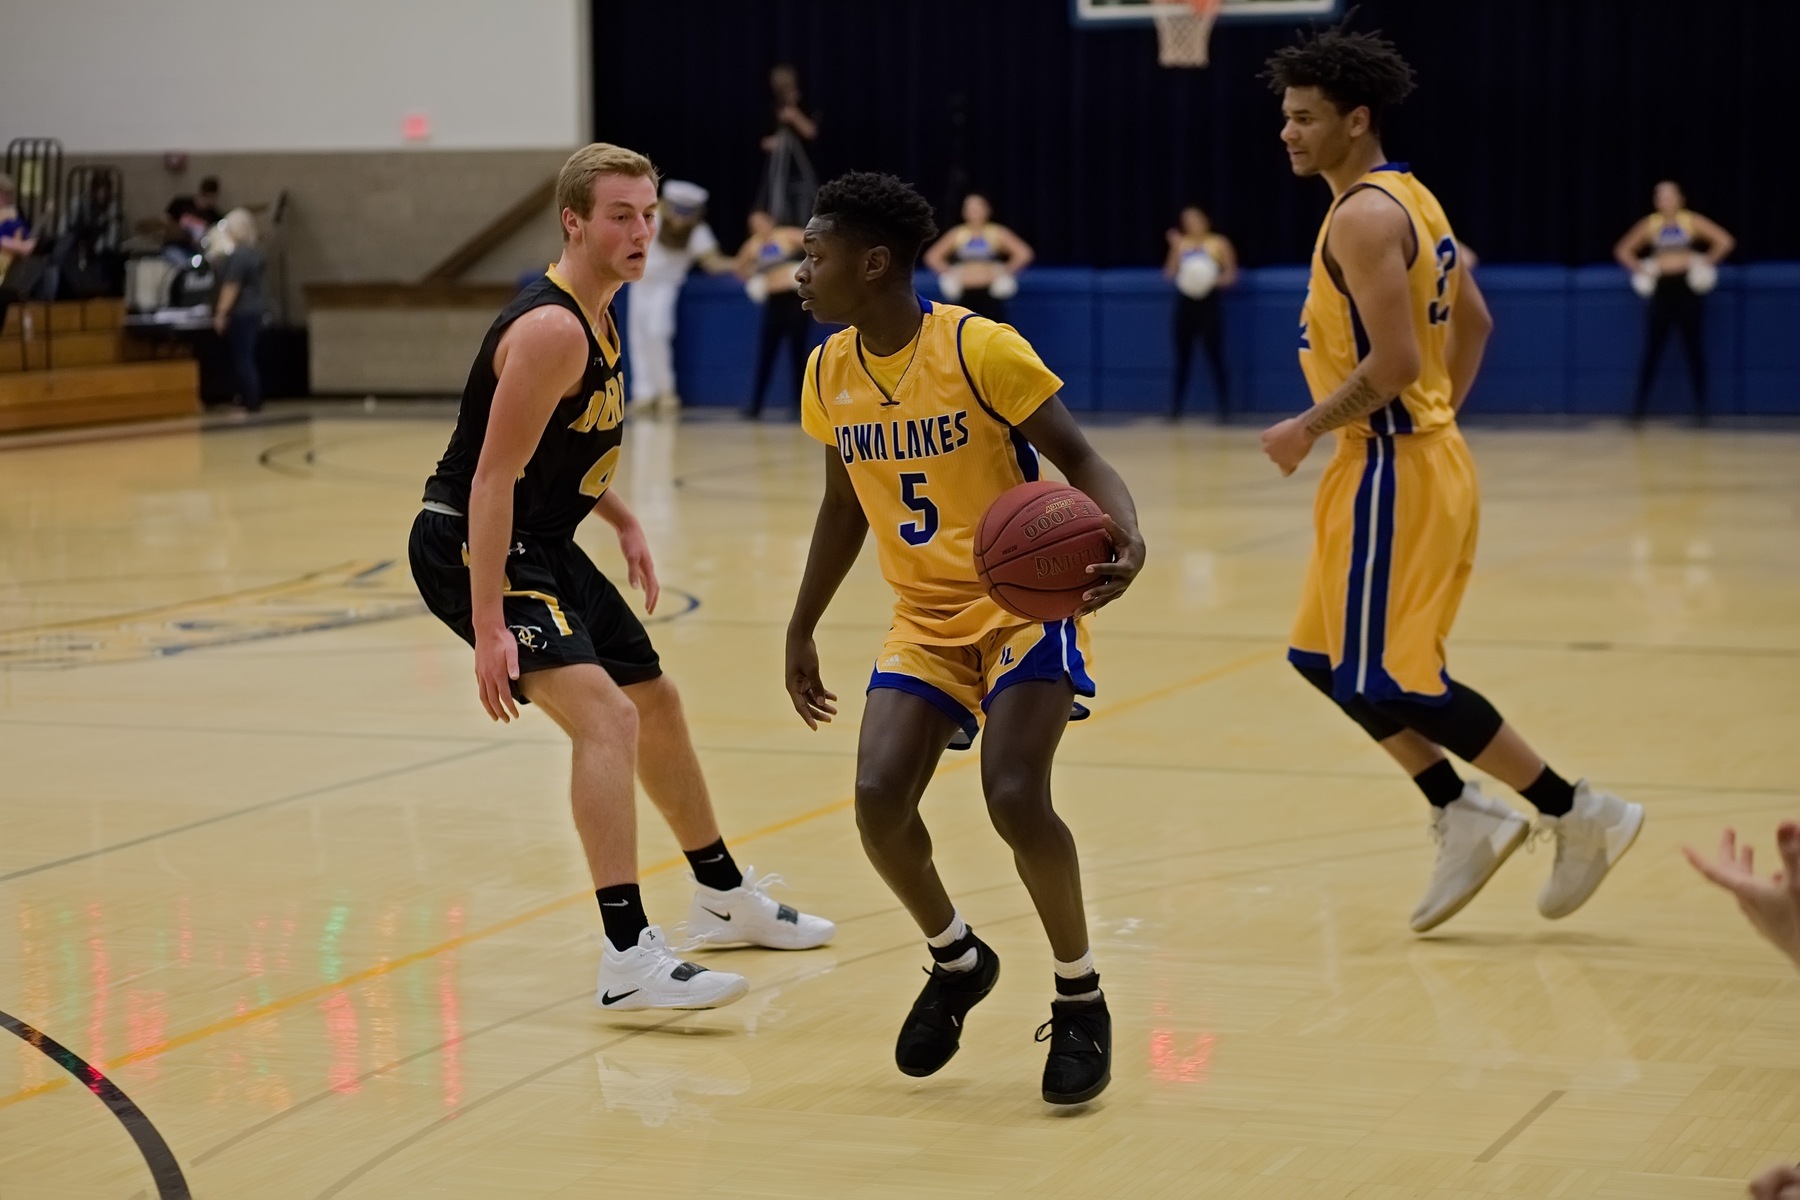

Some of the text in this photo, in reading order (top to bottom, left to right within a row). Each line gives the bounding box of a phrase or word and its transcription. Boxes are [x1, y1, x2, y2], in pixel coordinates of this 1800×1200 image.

[834, 410, 969, 466] IOWA LAKES
[898, 472, 940, 547] 5
